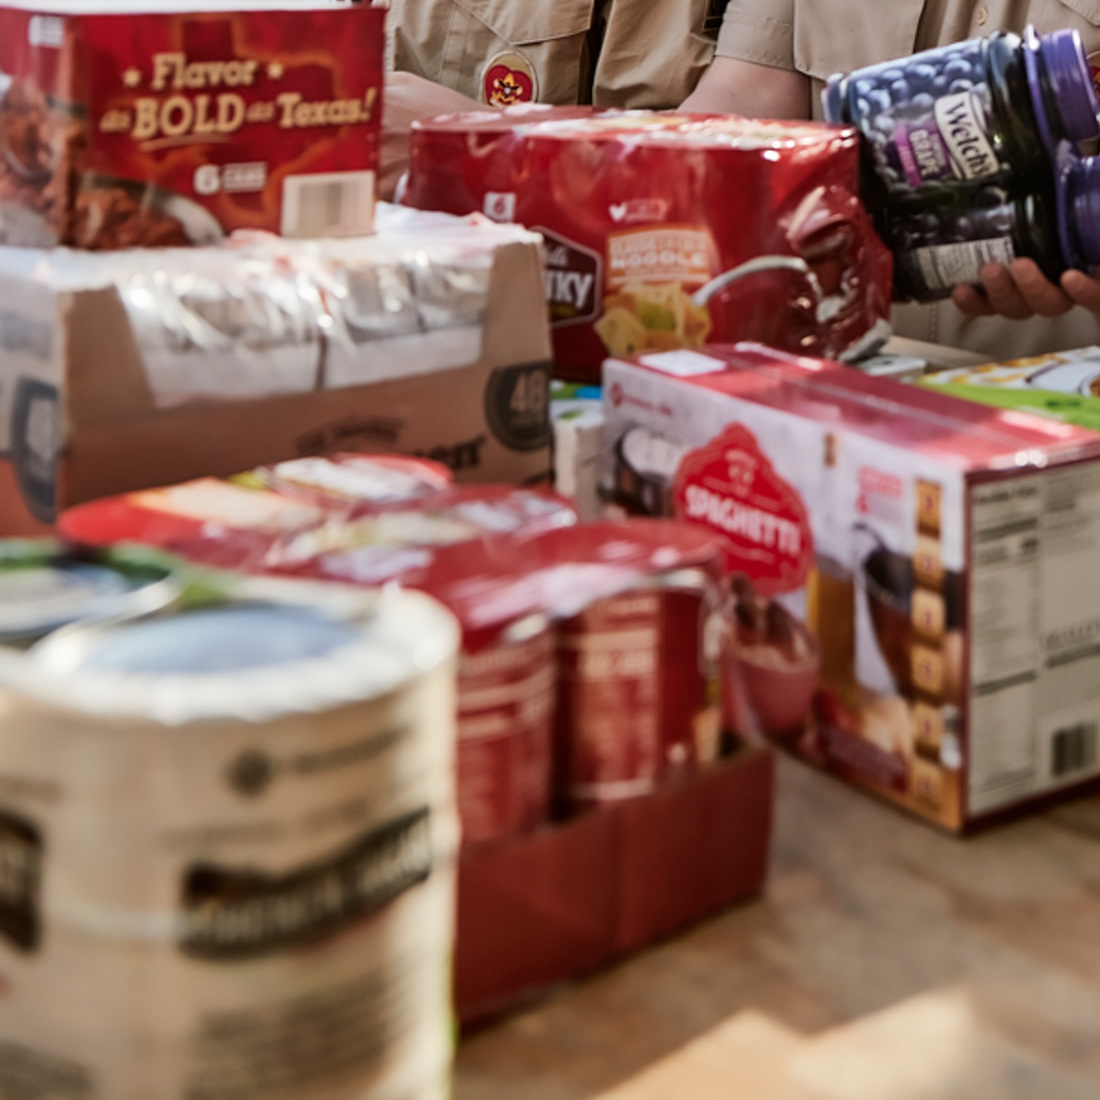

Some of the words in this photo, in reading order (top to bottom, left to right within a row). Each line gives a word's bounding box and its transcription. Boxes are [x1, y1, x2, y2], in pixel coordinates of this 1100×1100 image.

[152, 53, 258, 90] Flavor
[132, 93, 246, 139] BOLD
[276, 87, 378, 129] Texas!
[609, 251, 706, 270] NOODLE
[685, 484, 800, 557] SPAGHETTI
